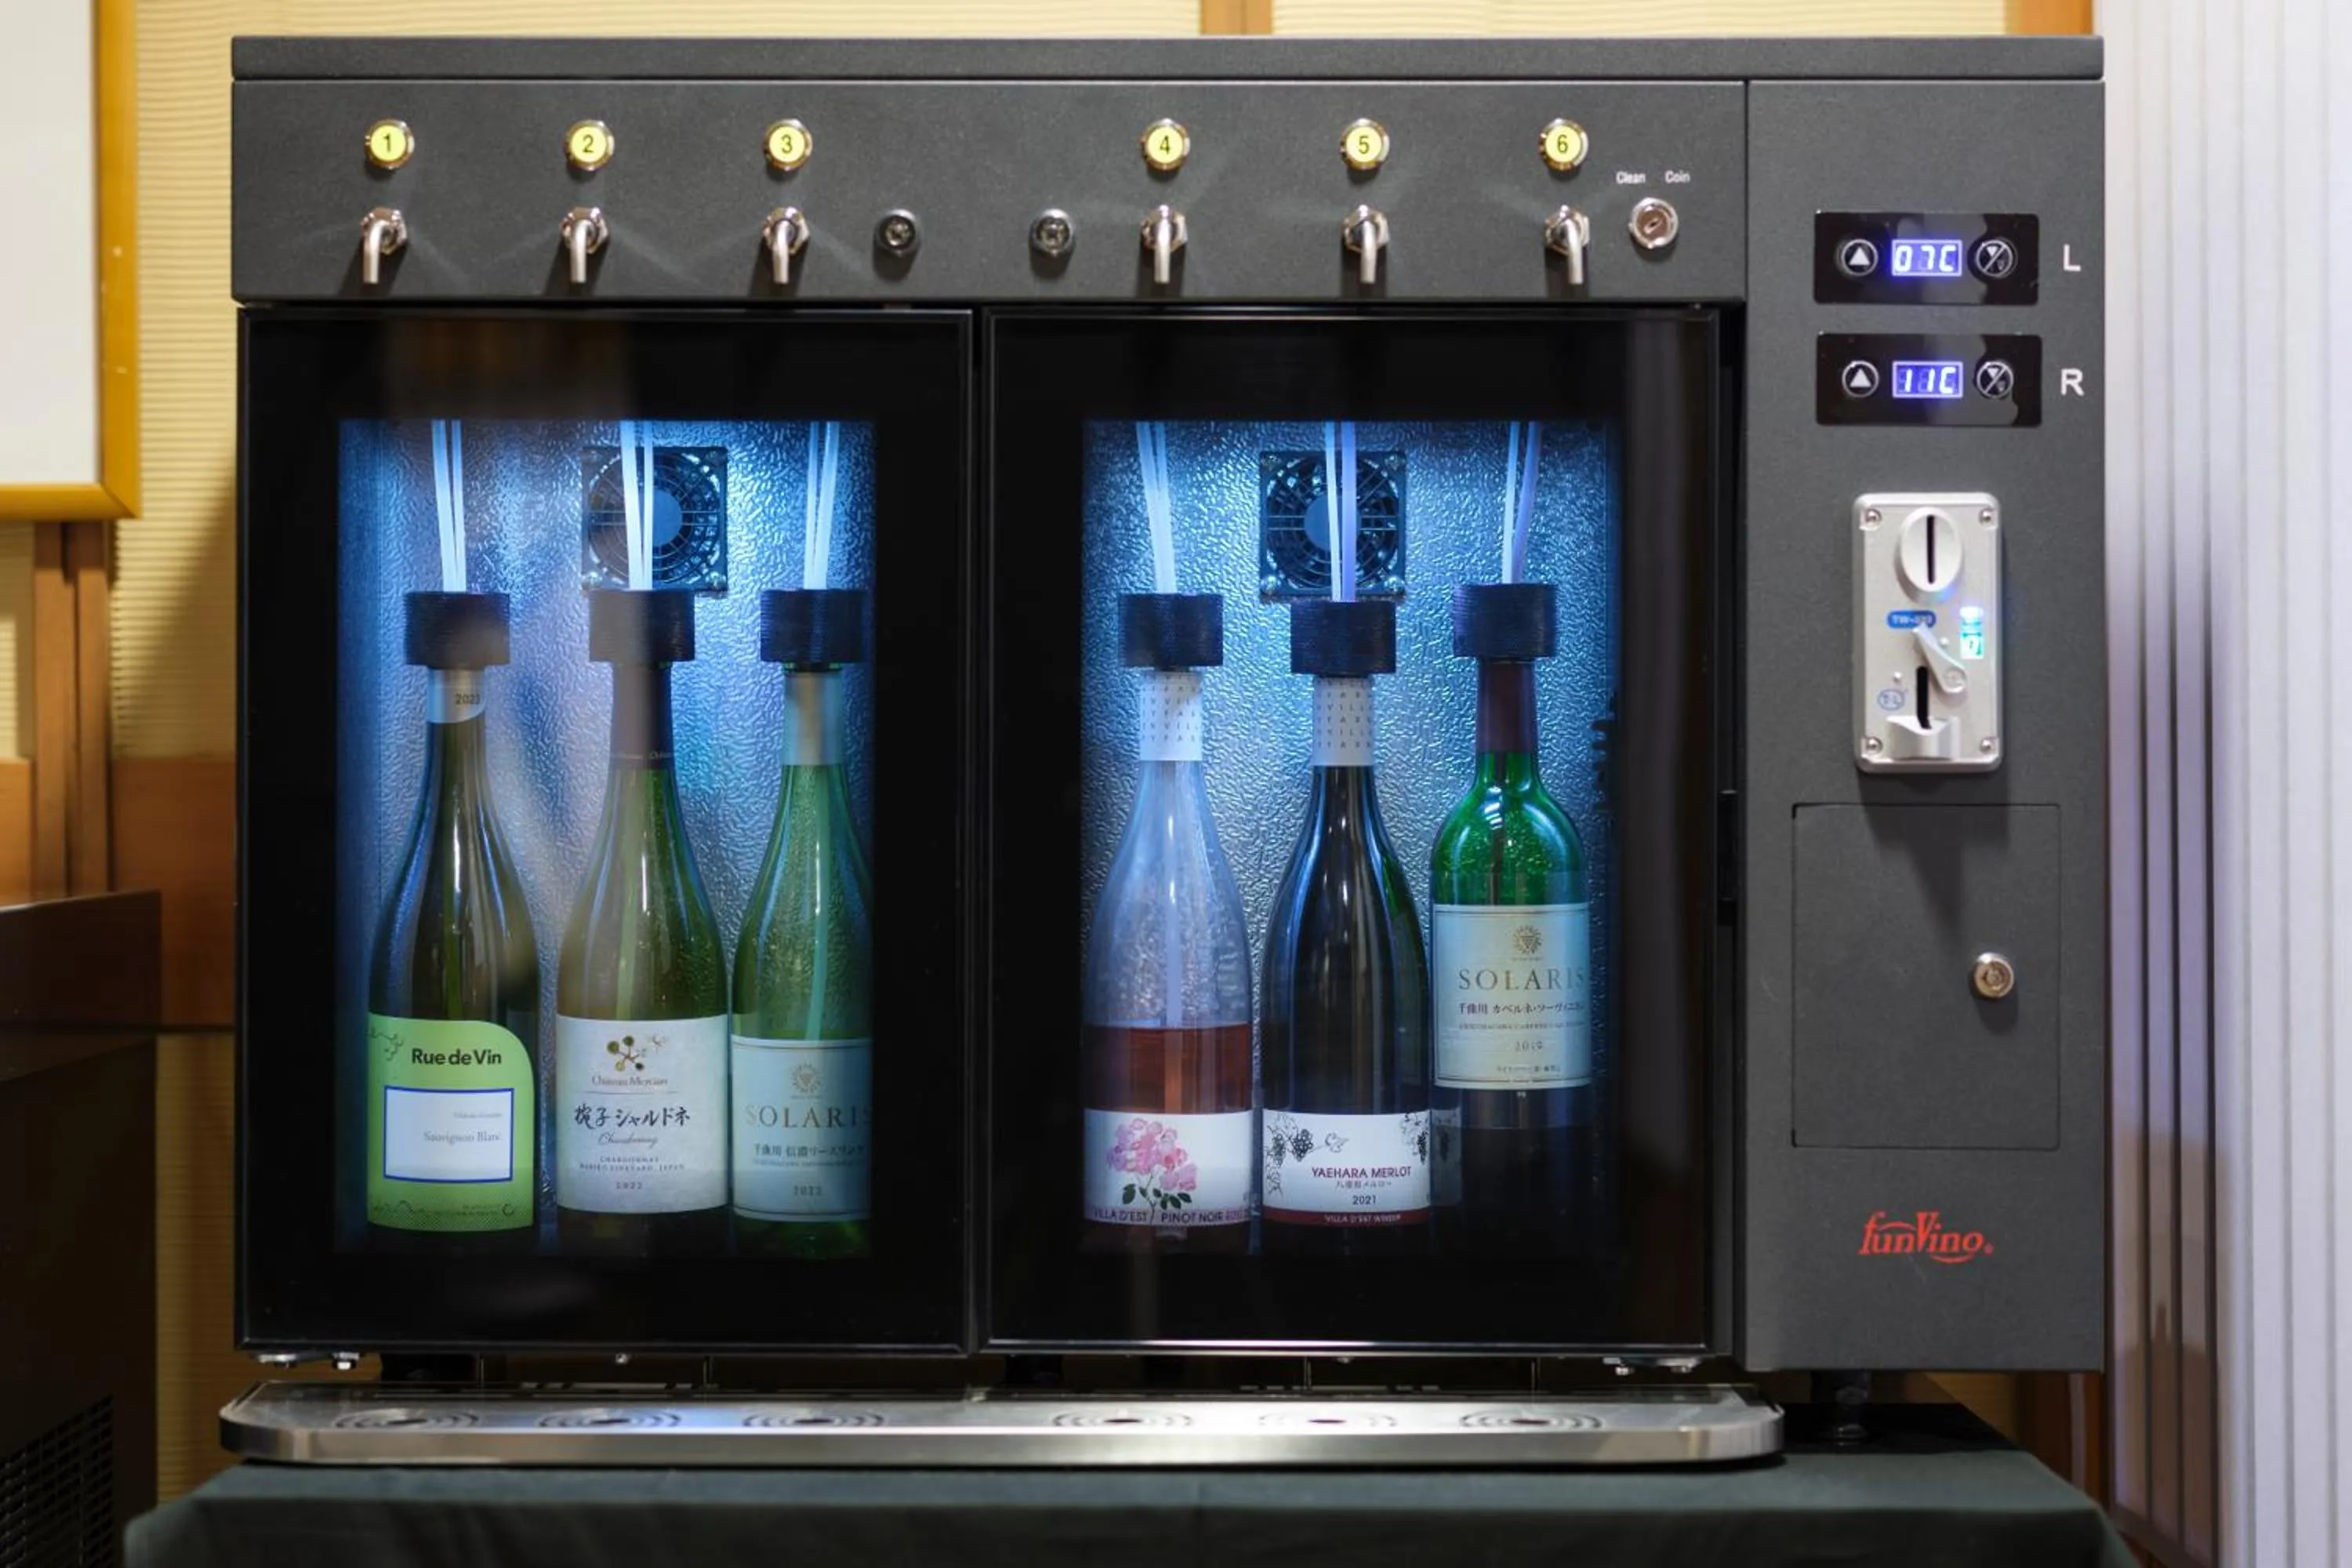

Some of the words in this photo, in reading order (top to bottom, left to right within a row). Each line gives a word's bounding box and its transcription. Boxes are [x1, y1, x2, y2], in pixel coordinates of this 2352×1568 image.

[383, 132, 391, 153] 1
[583, 134, 594, 154] 2
[781, 134, 793, 154] 3
[1160, 135, 1171, 154] 4
[1358, 135, 1370, 154] 5
[1557, 134, 1569, 154] 6
[1664, 169, 1690, 183] Coin
[2063, 244, 2082, 271] L
[2060, 368, 2085, 396] R
[1458, 967, 1584, 991] SOLARIS
[412, 1047, 445, 1065] Rue
[448, 1048, 471, 1065] de
[473, 1050, 503, 1065] Vin
[1312, 1167, 1368, 1179] YAEHARA
[1370, 1166, 1412, 1178] MERLOT
[1352, 1194, 1377, 1206] 2021
[1160, 1211, 1196, 1224] PINOT
[1199, 1211, 1224, 1223] NOIR
